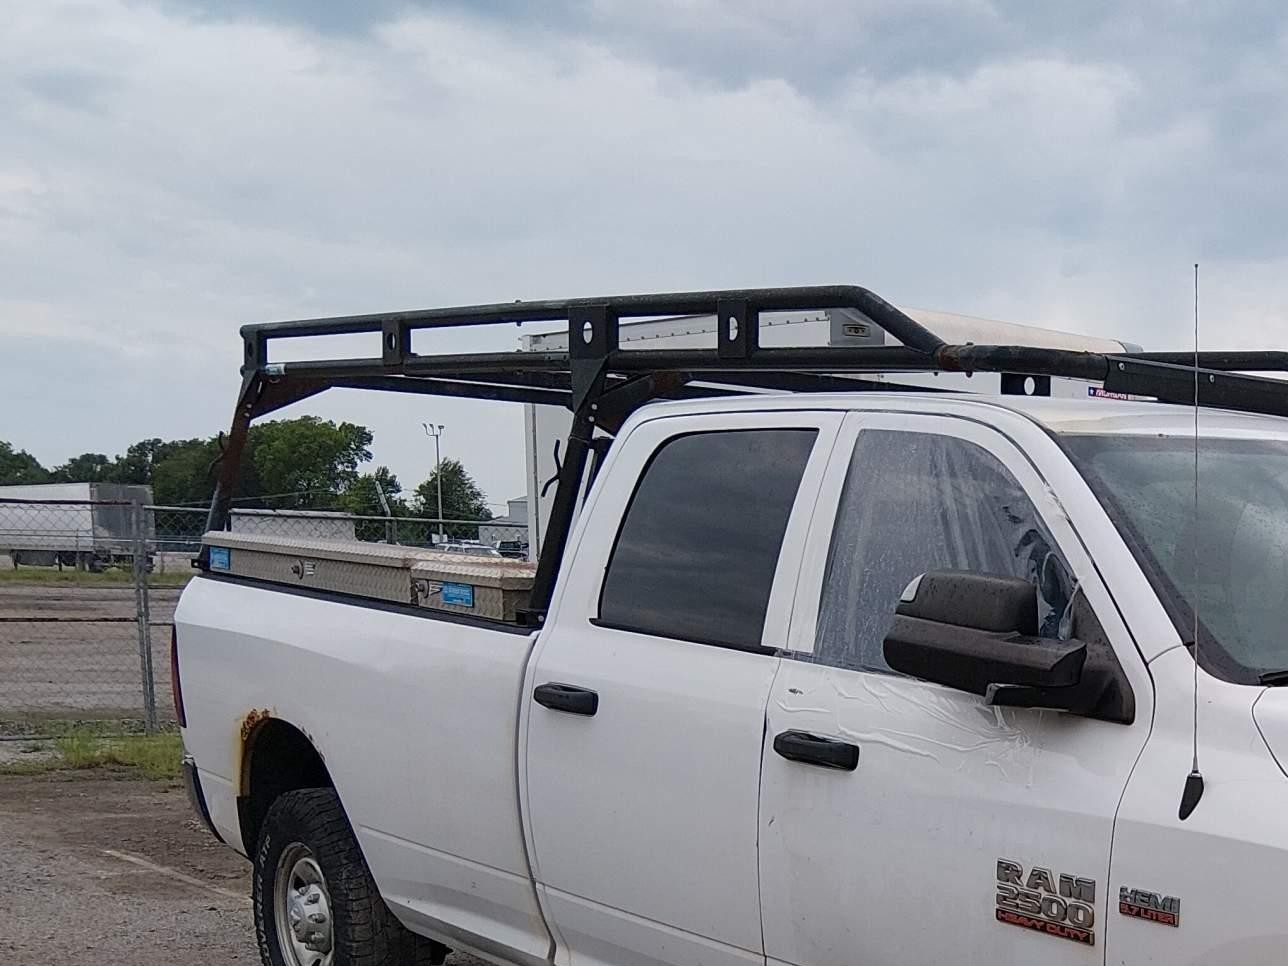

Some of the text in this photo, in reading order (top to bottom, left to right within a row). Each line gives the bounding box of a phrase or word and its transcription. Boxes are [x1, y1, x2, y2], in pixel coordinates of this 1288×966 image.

[996, 858, 1096, 904] RAM
[1119, 886, 1181, 913] HEMI
[996, 882, 1095, 929] 2500
[998, 910, 1089, 941] HEAVY DUTY
